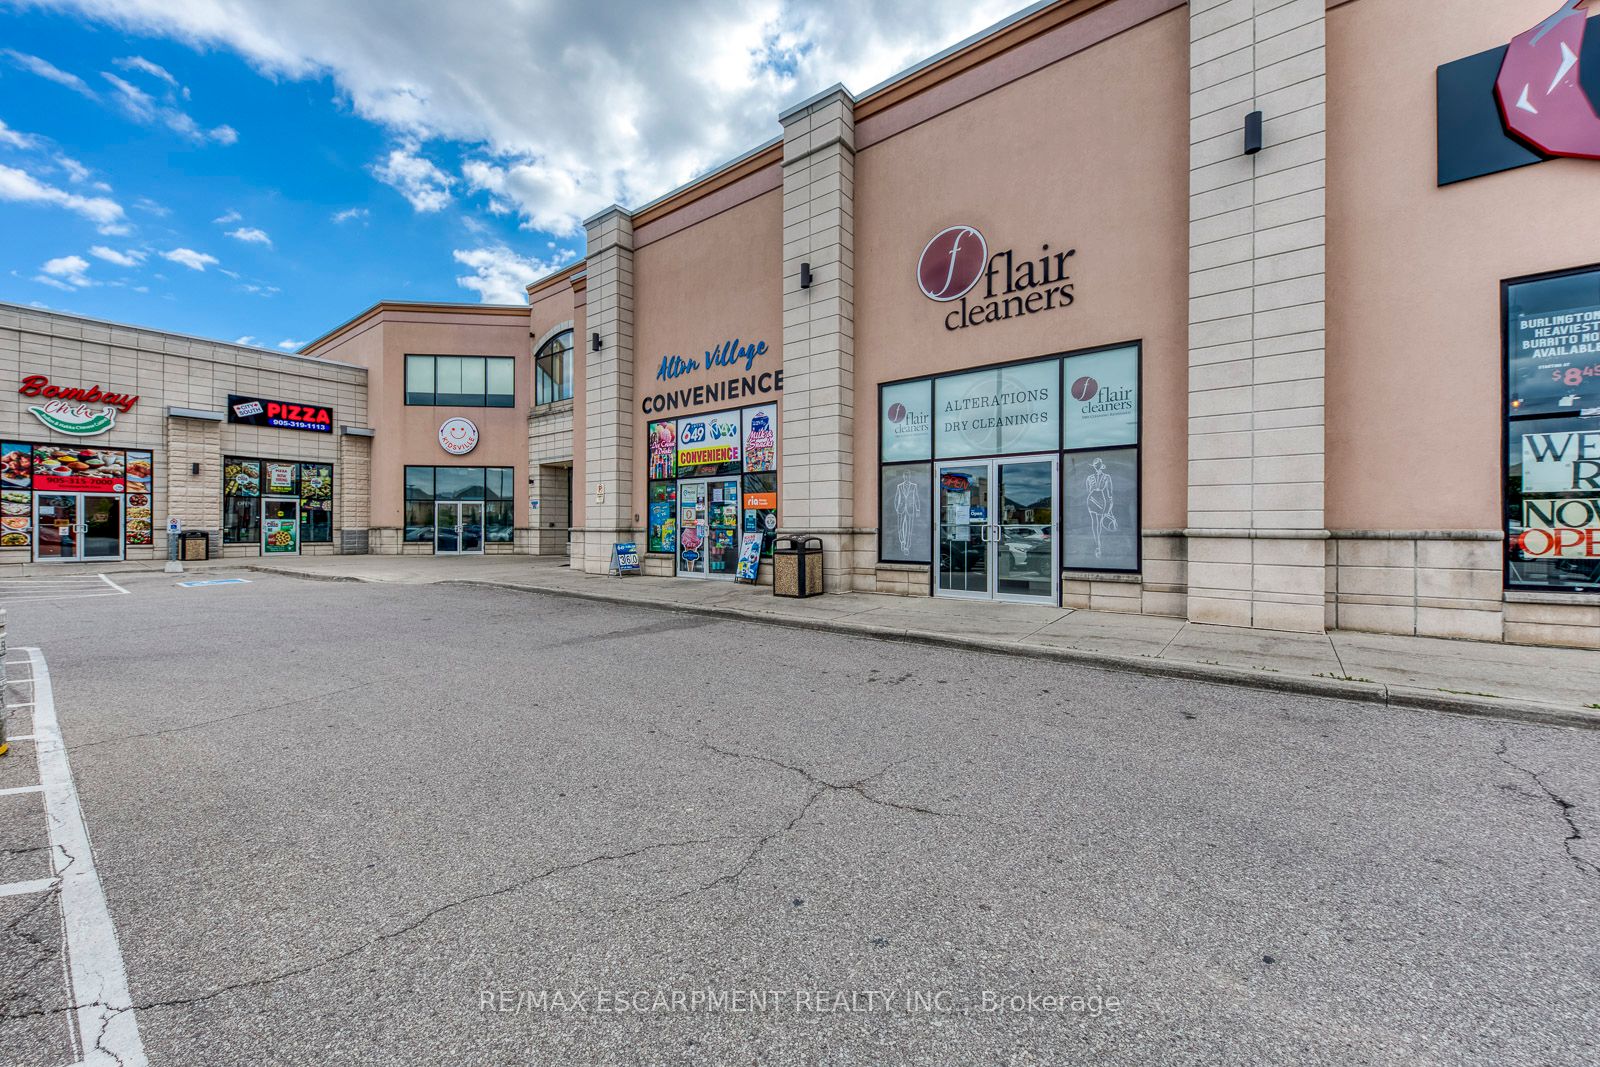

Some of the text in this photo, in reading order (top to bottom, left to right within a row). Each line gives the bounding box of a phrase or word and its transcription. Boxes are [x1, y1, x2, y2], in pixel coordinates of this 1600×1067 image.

[983, 243, 1076, 299] flair
[944, 283, 1075, 331] cleaners
[1520, 310, 1600, 330] BURLINGTON
[1534, 321, 1600, 338] HEAVIEST
[1522, 335, 1578, 350] BURRITO
[1532, 342, 1600, 359] AVAILABLE
[656, 338, 769, 382] Alton Village
[18, 374, 140, 413] Bombay
[642, 369, 784, 415] CONVENIENCE
[944, 388, 1049, 413] ALTERATIONS
[1098, 386, 1133, 403] flair
[239, 407, 262, 416] SOUTH
[240, 403, 254, 411] CITY
[267, 402, 331, 424] PIZZA
[1081, 400, 1133, 414] cleaners
[273, 419, 326, 431] 905-319-1113
[906, 411, 929, 425] flair
[944, 411, 1048, 432] DRY CLEANINGS
[894, 423, 929, 434] cleaners
[442, 436, 475, 451] KIDSVILLE
[1526, 431, 1600, 462] WE
[680, 447, 739, 464] CONVENIENCE
[942, 474, 970, 490] OPEN
[1572, 460, 1600, 490] R
[747, 495, 759, 506] ria
[1525, 500, 1600, 528] NO
